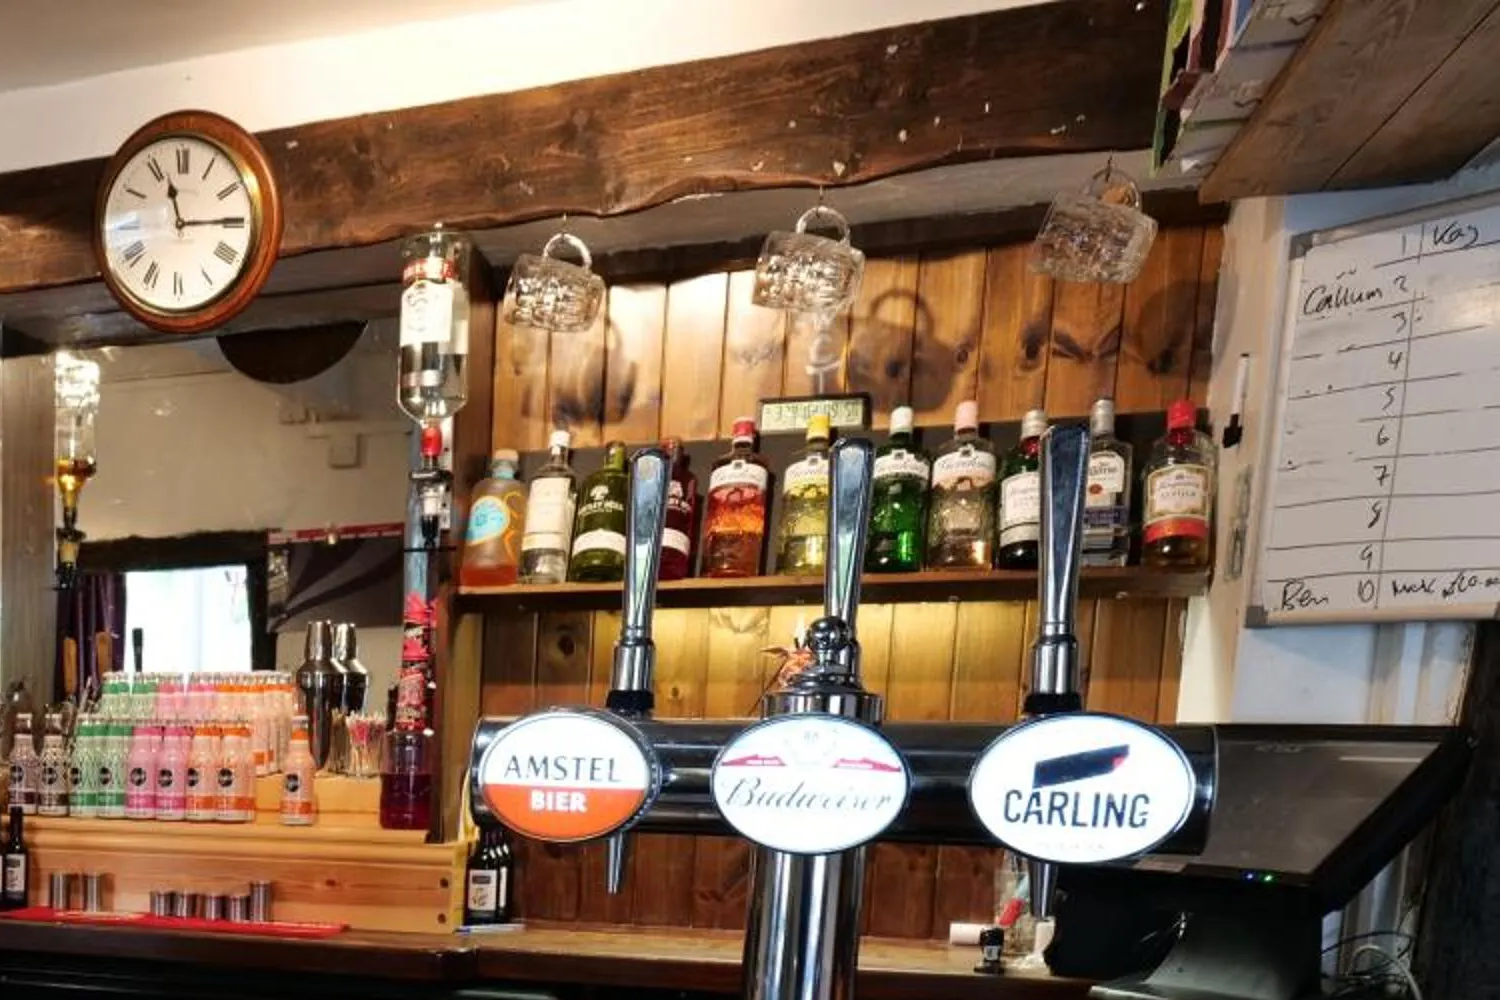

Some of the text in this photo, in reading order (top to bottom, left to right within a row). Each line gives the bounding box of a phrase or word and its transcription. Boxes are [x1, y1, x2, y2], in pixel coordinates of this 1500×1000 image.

[1387, 351, 1402, 370] 4
[1376, 426, 1390, 446] 6
[1373, 465, 1390, 486] 7
[504, 754, 621, 783] AMSTEL
[530, 789, 588, 814] BIER
[1003, 789, 1150, 829] CARLING
